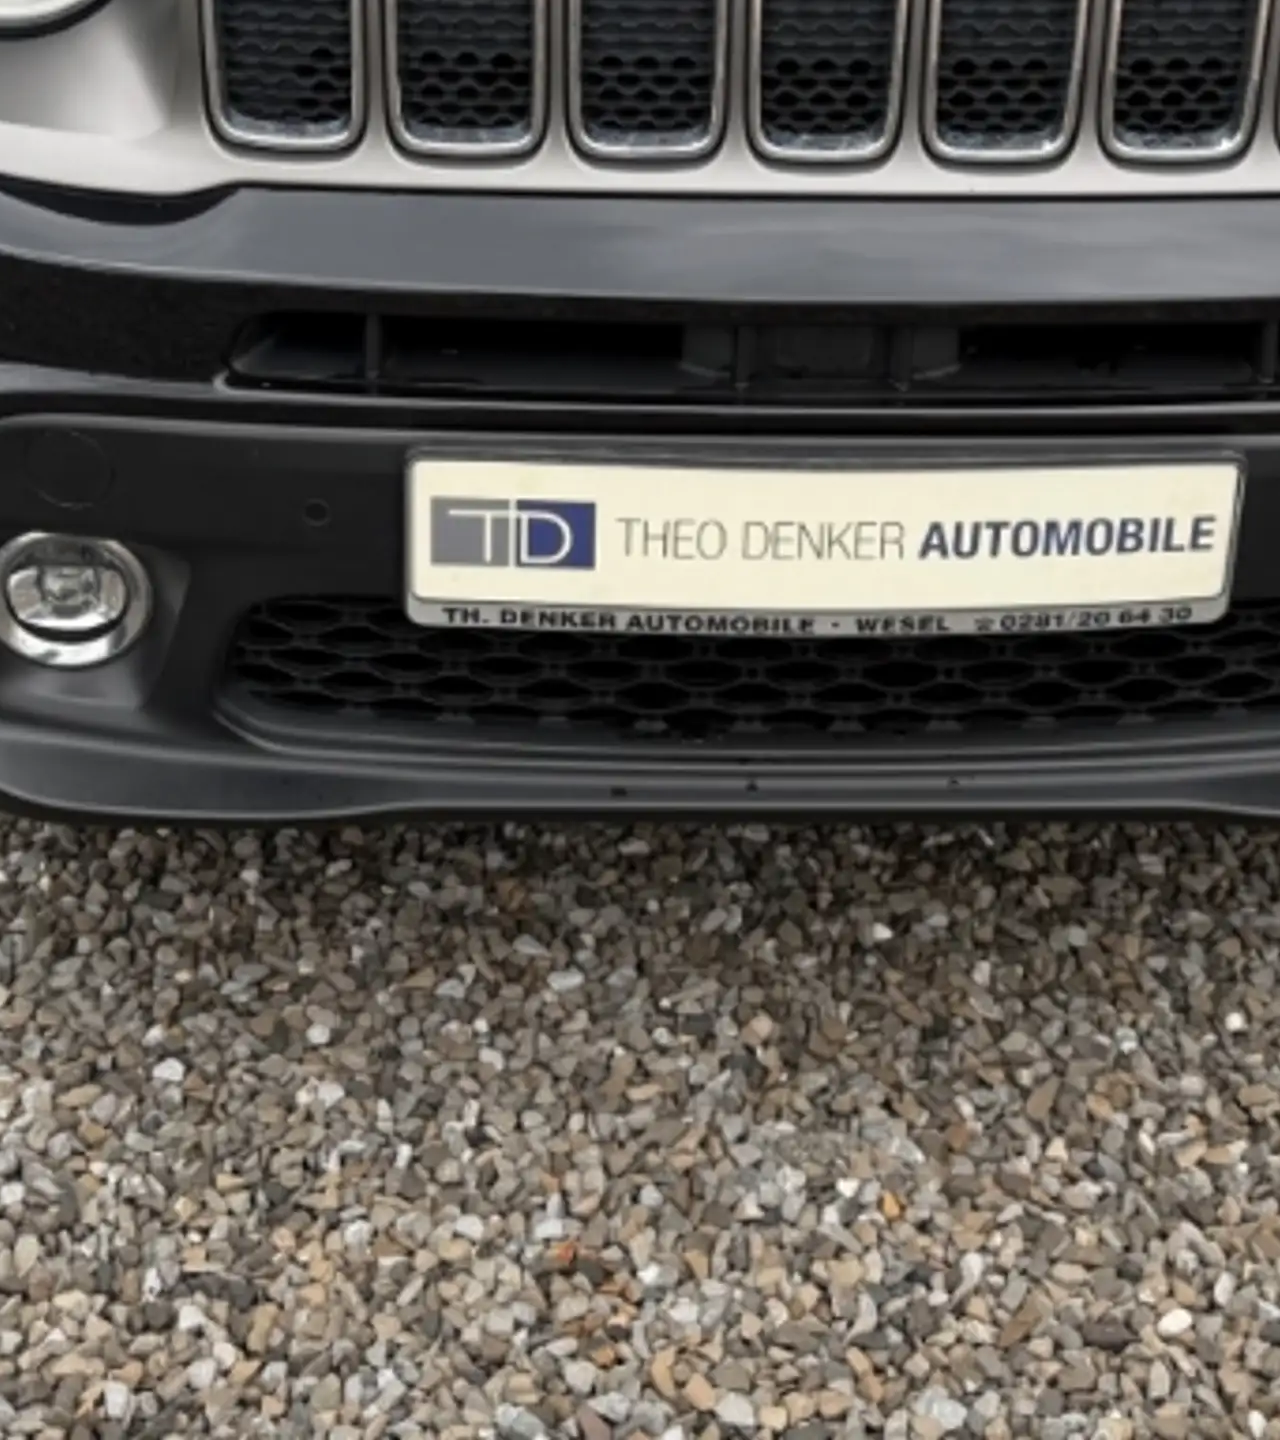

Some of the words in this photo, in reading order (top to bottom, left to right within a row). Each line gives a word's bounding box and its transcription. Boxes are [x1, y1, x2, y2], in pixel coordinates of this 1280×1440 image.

[446, 508, 575, 565] TD
[616, 517, 728, 559] THEO
[741, 520, 906, 561] DENKER
[920, 514, 1217, 560] AUTOMOBILE
[441, 607, 490, 625] TH.
[500, 608, 616, 628] DENKER
[624, 614, 816, 633] AUTOMOBILE
[855, 615, 950, 633] WESEL
